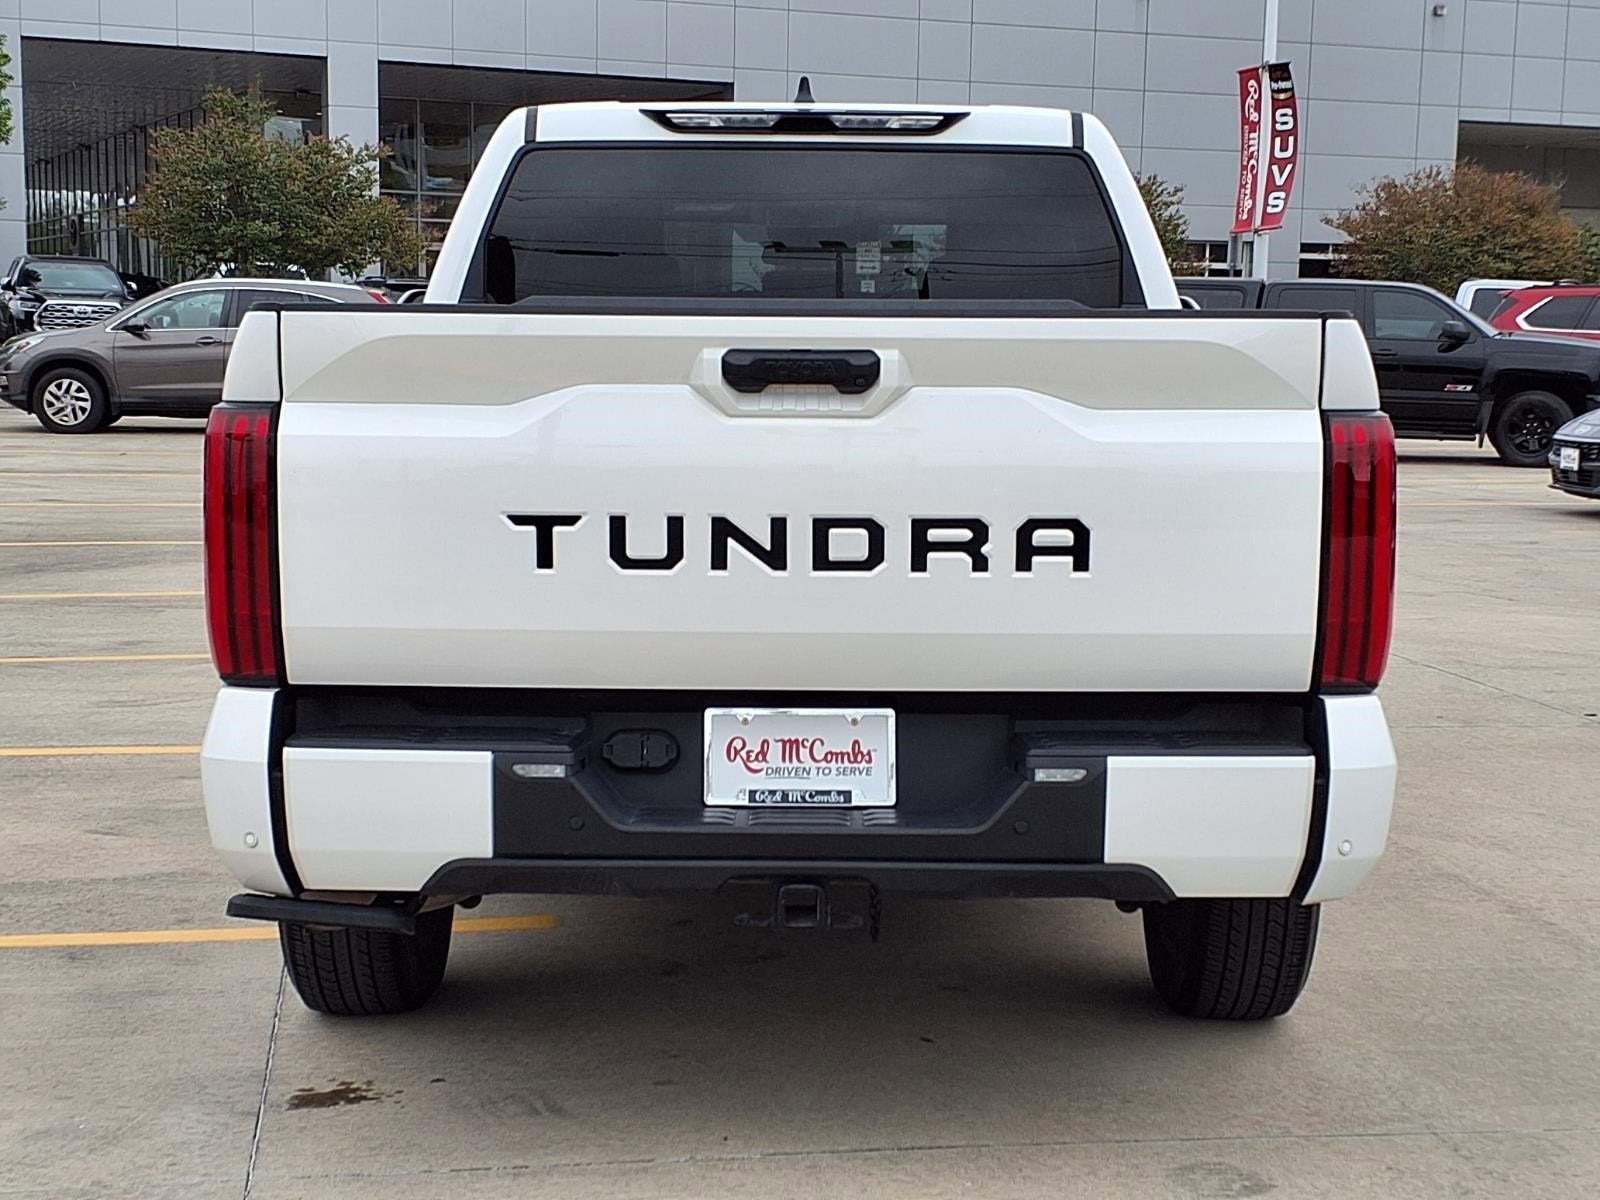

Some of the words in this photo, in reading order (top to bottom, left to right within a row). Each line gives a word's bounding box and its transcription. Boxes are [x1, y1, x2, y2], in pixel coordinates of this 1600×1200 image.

[1245, 79, 1260, 123] Red
[1266, 107, 1295, 214] SUVS
[1241, 170, 1247, 185] TO
[766, 360, 836, 377] TOYOTA
[500, 512, 1093, 577] TUNDRA
[726, 736, 771, 774] Red
[774, 737, 874, 765] McCombs
[765, 766, 812, 777] DRIVEN
[815, 766, 832, 776] TO
[835, 766, 873, 776] SERVE
[755, 790, 783, 803] Red
[784, 790, 845, 803] McCombs
